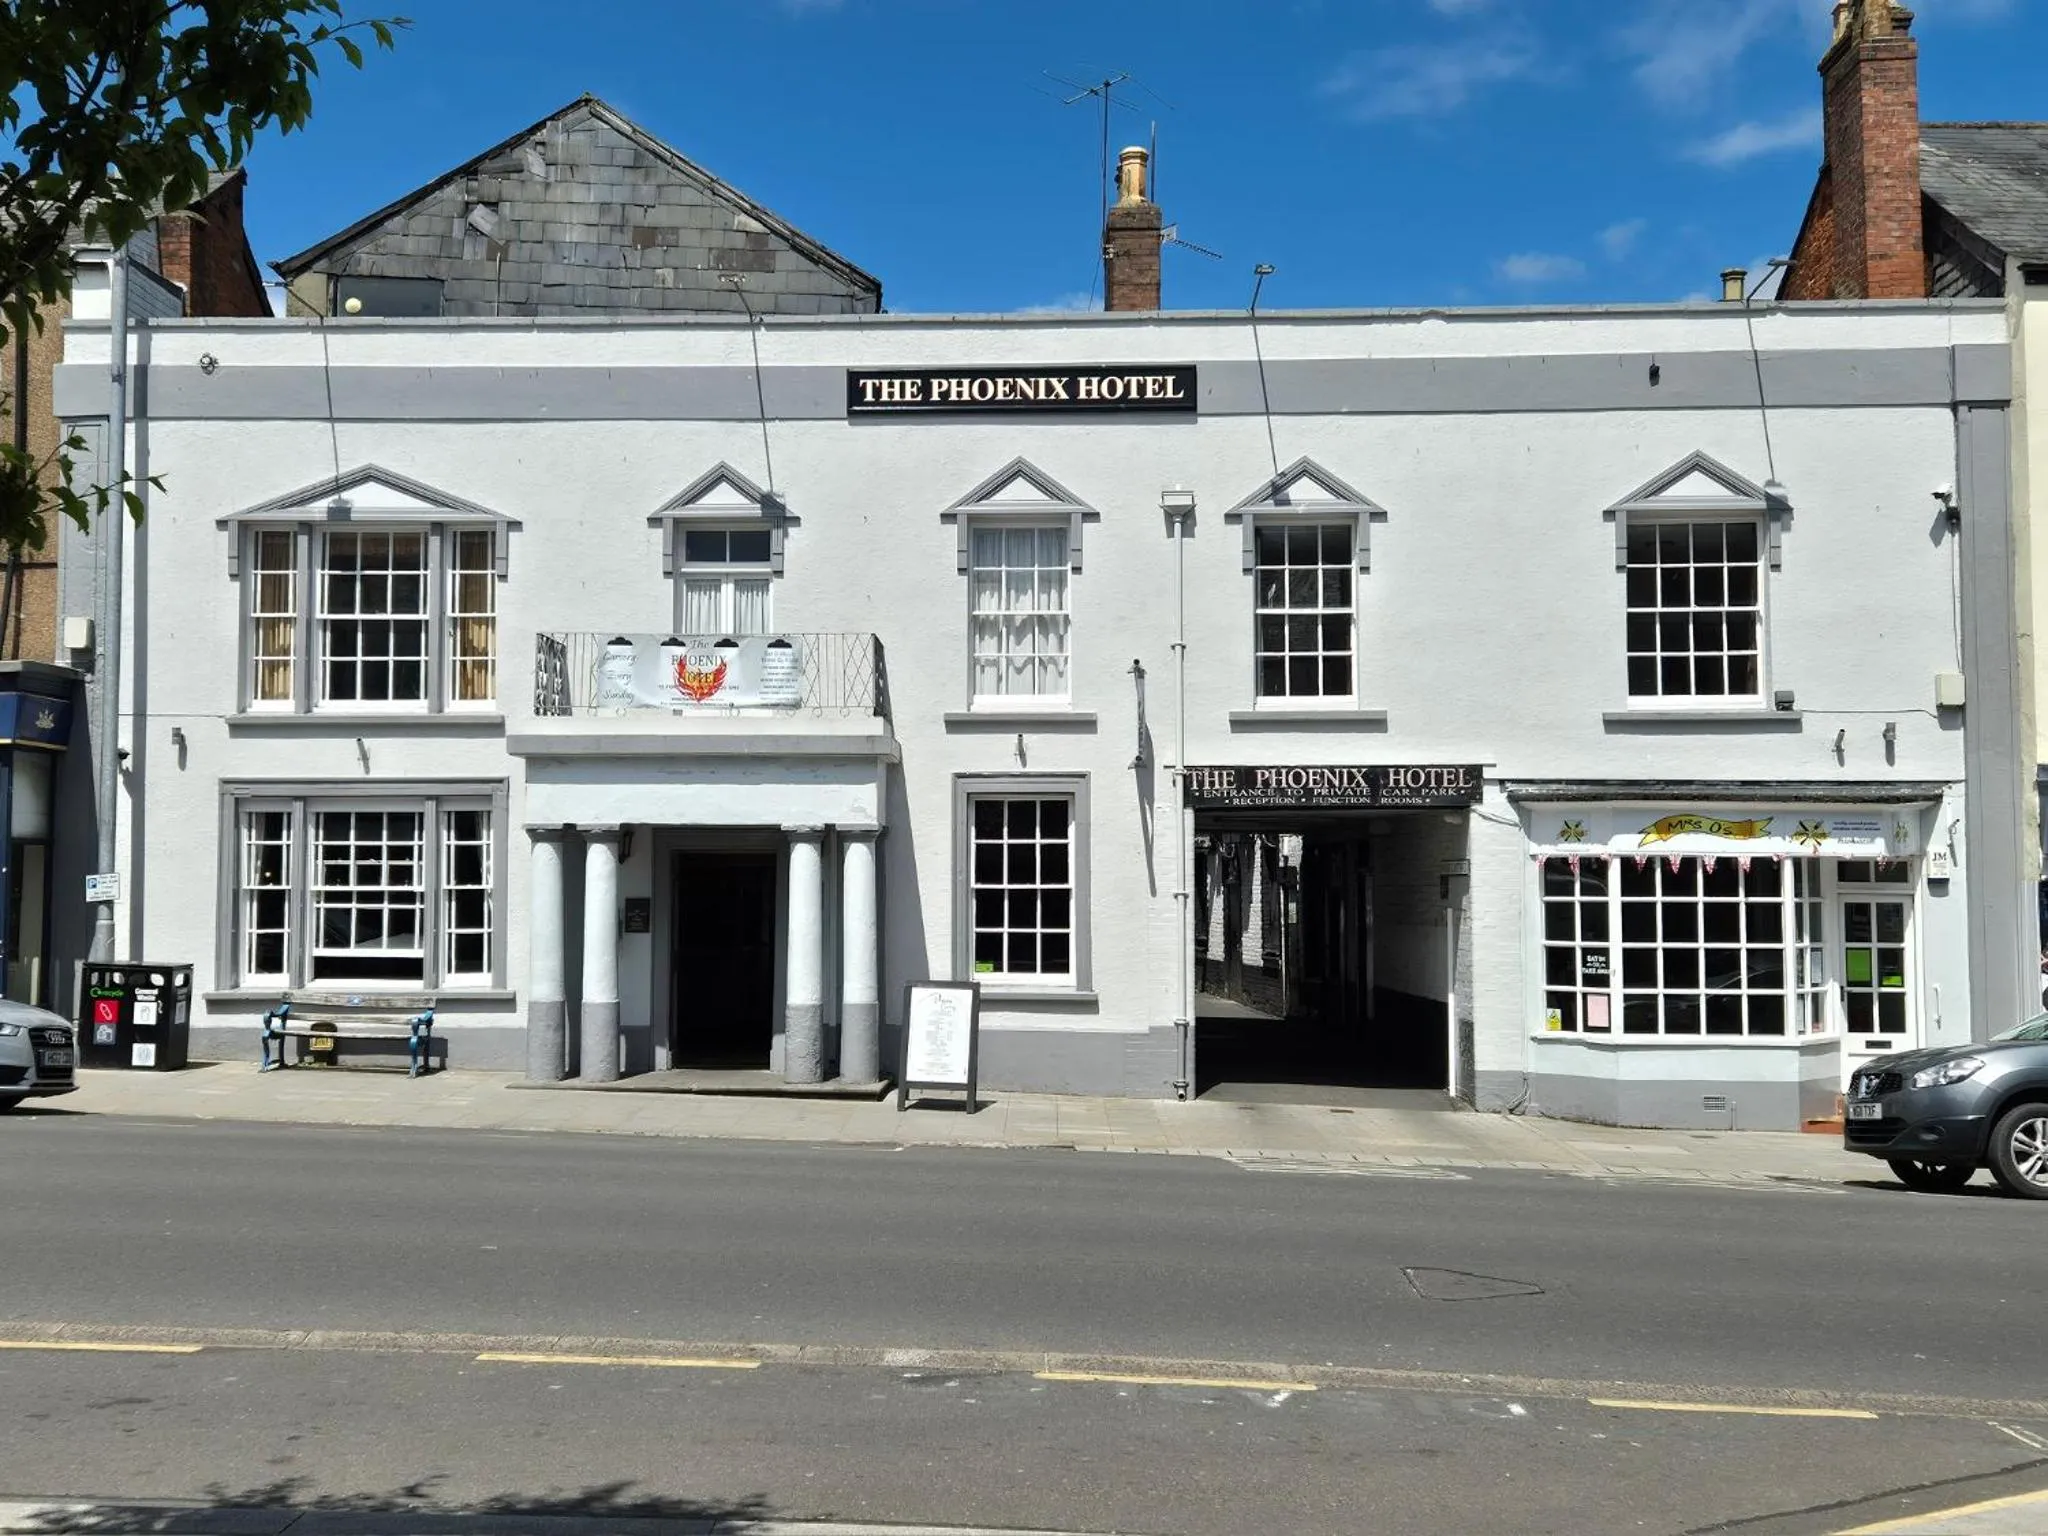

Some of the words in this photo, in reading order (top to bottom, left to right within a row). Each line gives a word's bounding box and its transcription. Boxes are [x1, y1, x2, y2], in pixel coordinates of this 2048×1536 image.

[860, 378, 922, 402] THE
[930, 376, 1070, 402] PHOENIX
[1077, 375, 1185, 400] HOTEL
[1186, 769, 1237, 790] THE
[1255, 767, 1369, 789] PHOENIX
[1387, 767, 1473, 788] HOTEL
[1203, 788, 1276, 798] ENTRANCE
[1285, 788, 1304, 797] TO
[1313, 787, 1371, 797] PRIVATE
[1382, 788, 1410, 797] CAR
[1421, 787, 1457, 796] PARK
[1232, 796, 1296, 805] RECEPTION
[1312, 796, 1370, 804] FUNCTION
[1381, 796, 1423, 804] ROOMS
